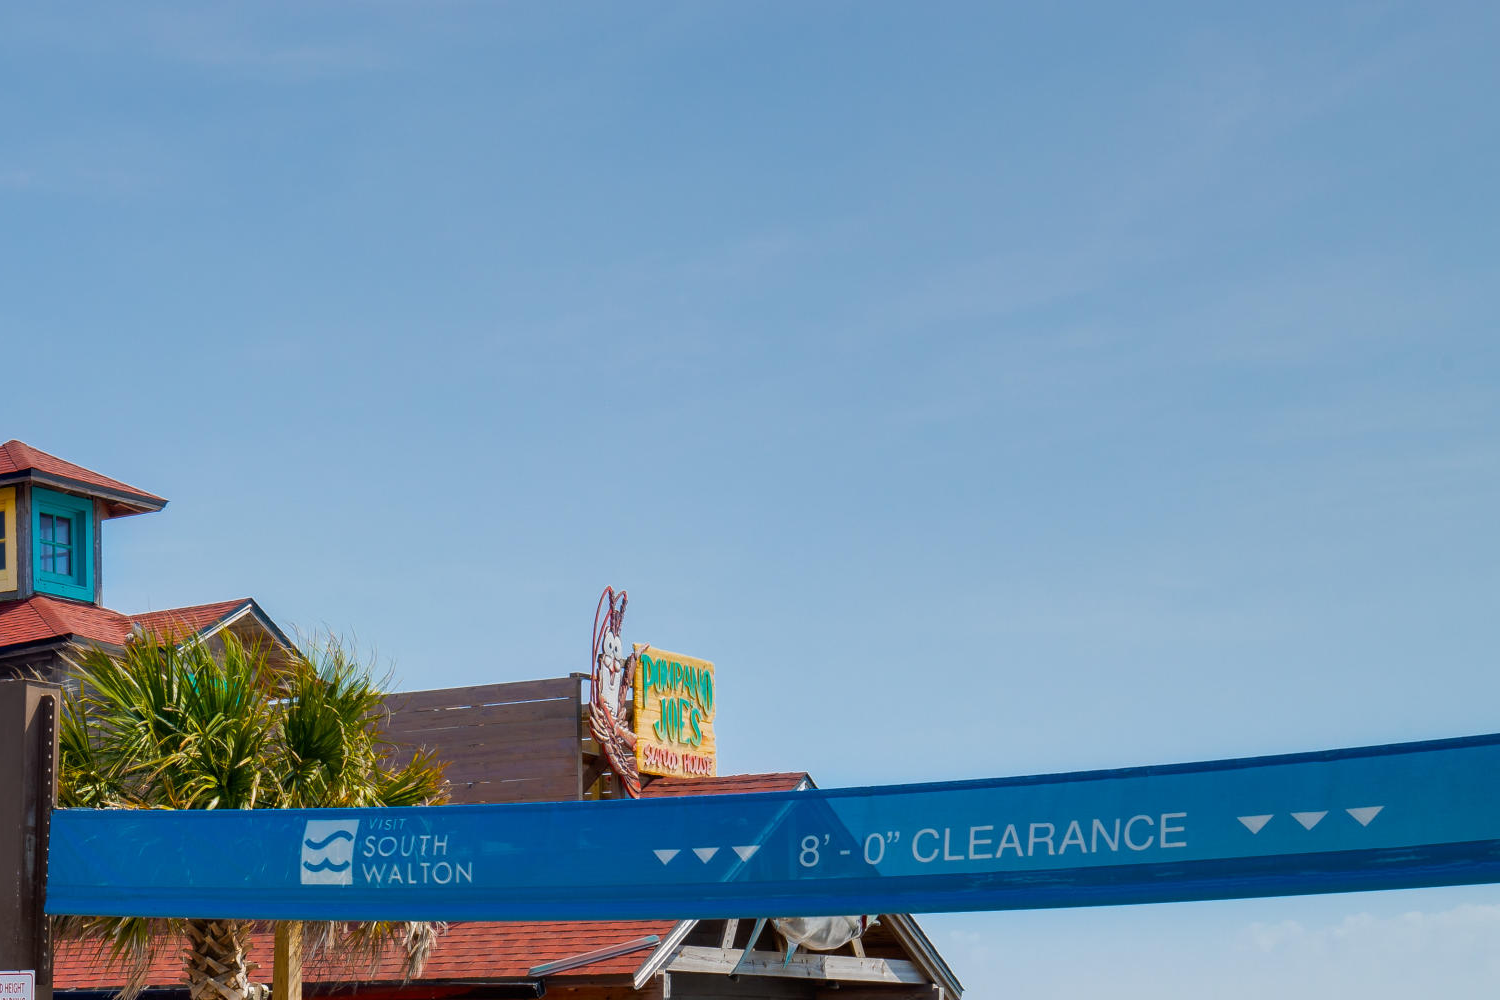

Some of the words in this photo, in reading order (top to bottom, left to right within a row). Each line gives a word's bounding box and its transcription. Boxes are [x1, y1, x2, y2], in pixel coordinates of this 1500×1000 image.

[641, 654, 713, 716] POMPANO
[653, 697, 702, 747] JOE'S
[644, 744, 679, 770] SEAFOOD
[682, 753, 713, 776] HOUSE
[368, 818, 407, 830] VISIT
[912, 812, 1188, 863] CLEARANCE
[363, 835, 448, 857] SOUTH
[362, 862, 472, 884] WALTON
[5, 982, 25, 993] HEIGHT
